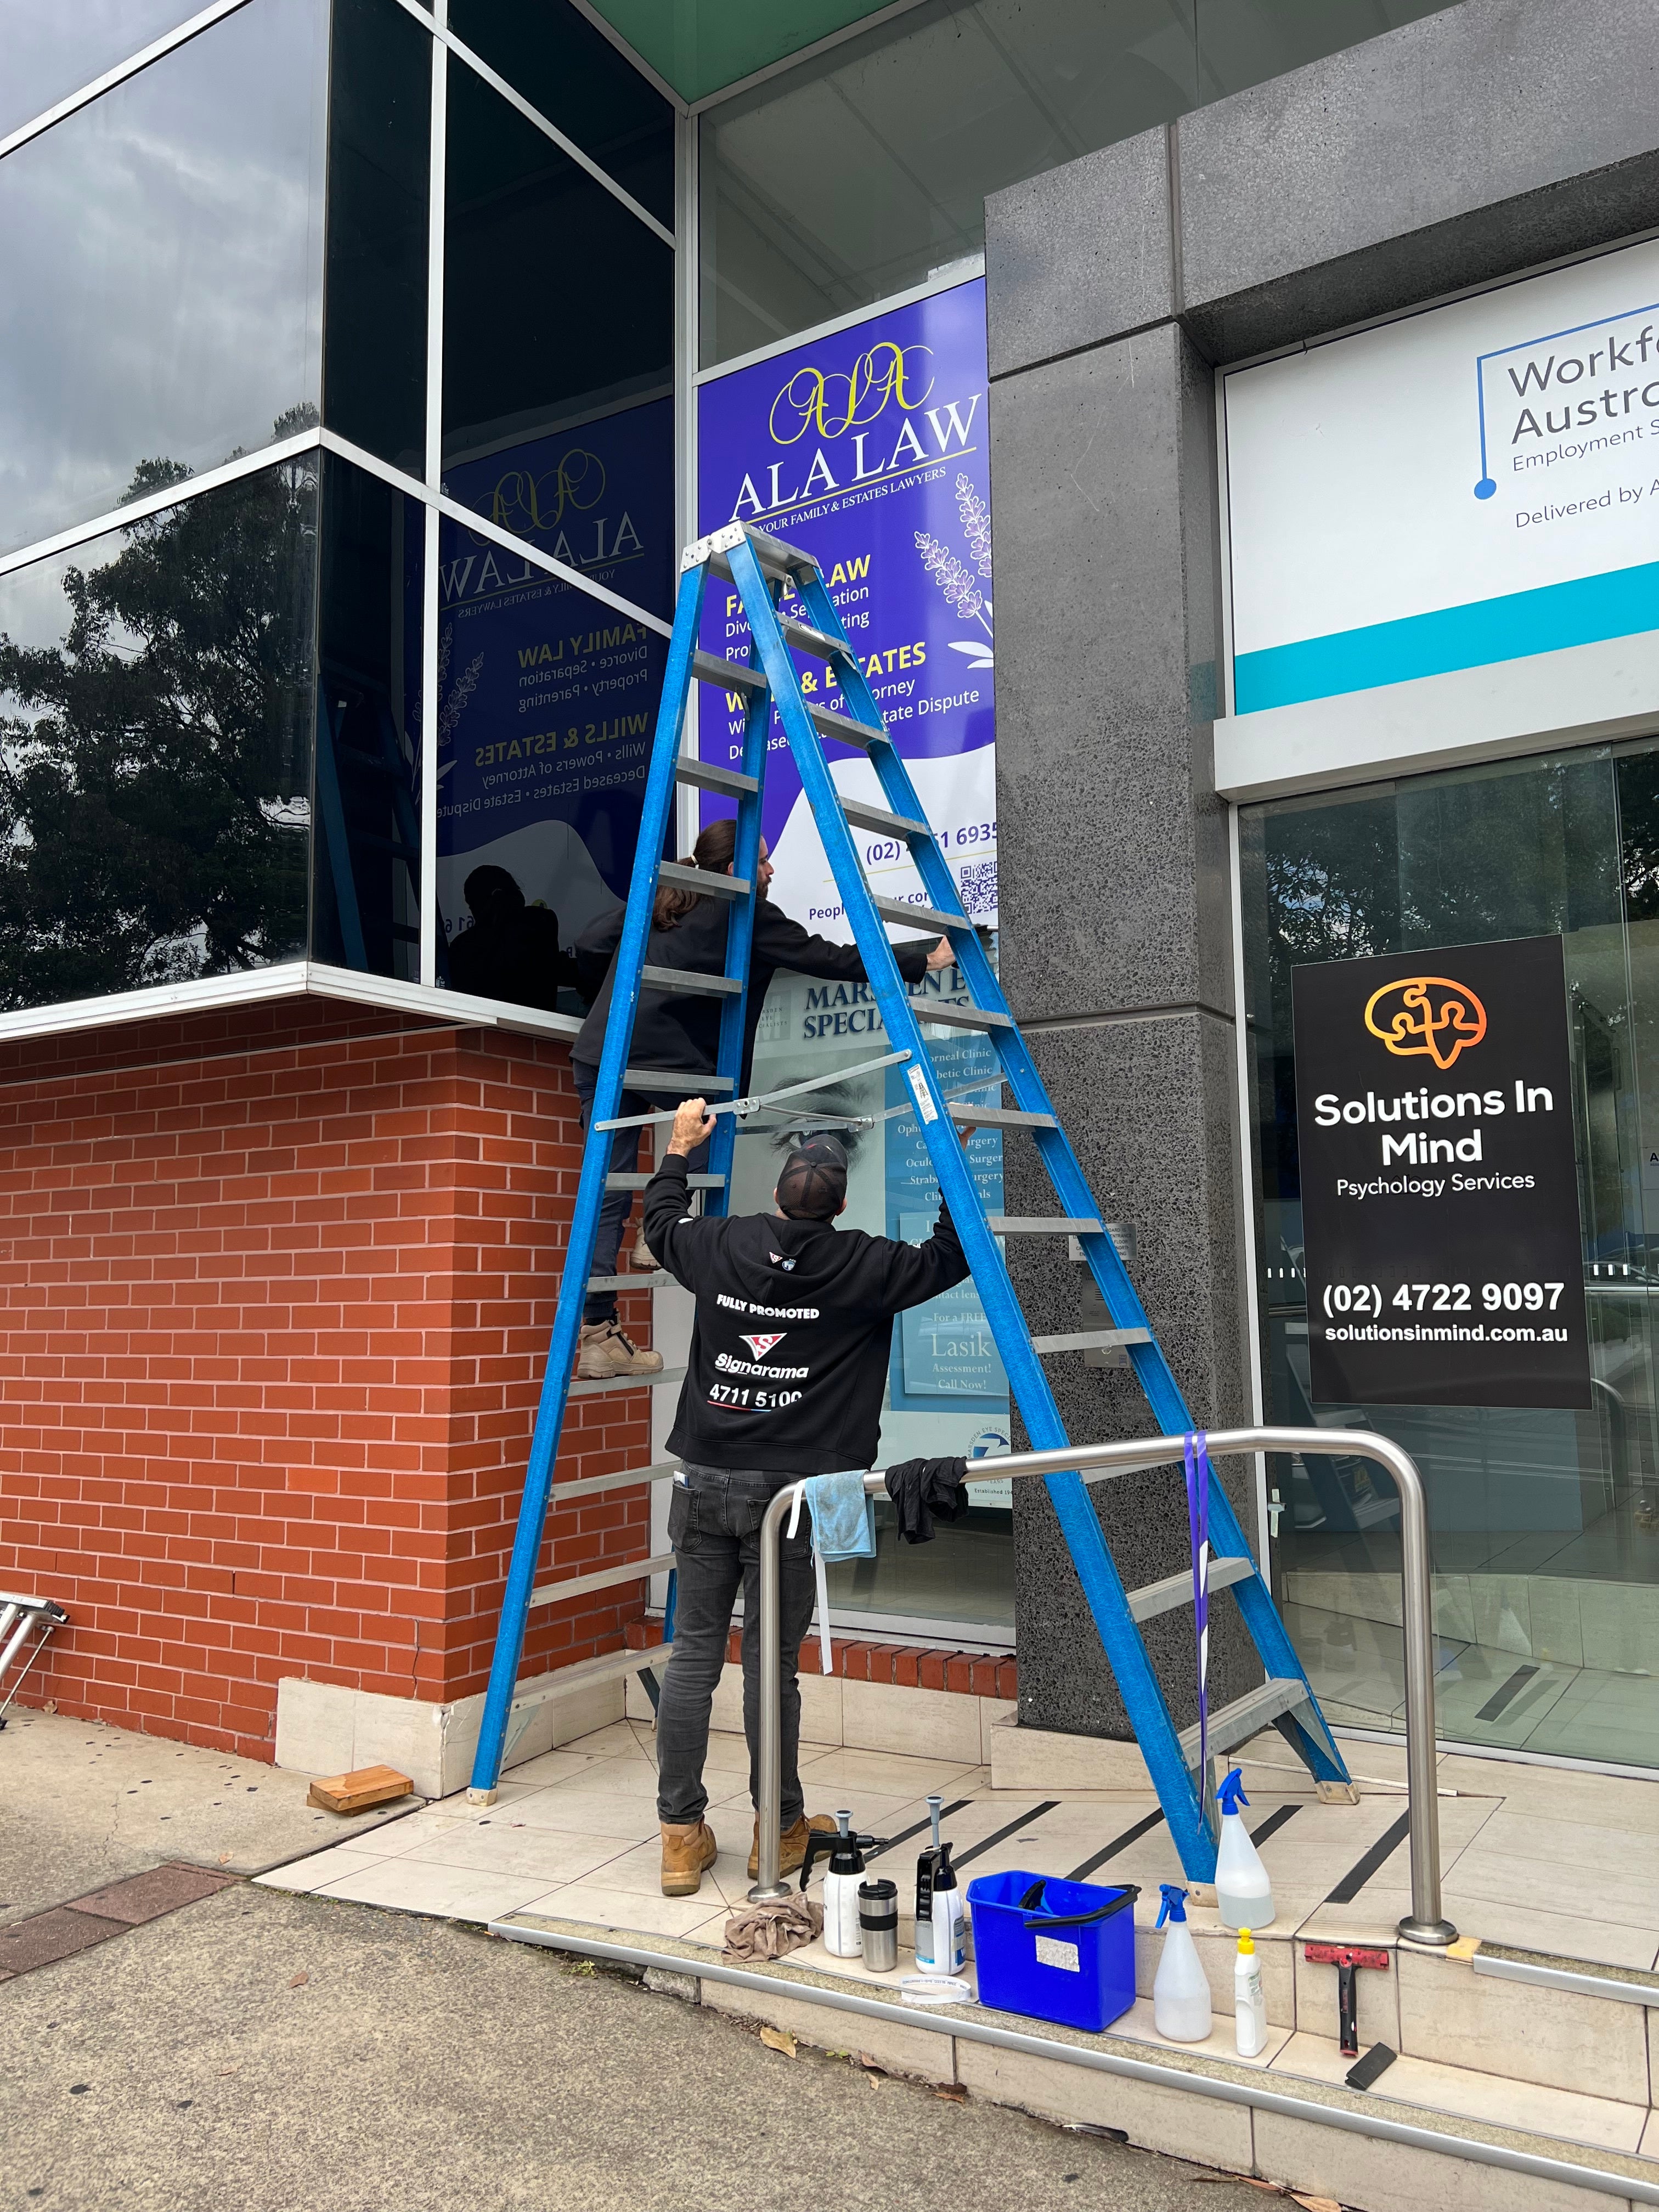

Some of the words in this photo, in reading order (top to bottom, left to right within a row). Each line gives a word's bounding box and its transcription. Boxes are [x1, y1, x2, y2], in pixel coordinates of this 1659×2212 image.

[1508, 325, 1659, 397] Workf
[729, 448, 839, 522] ALA
[851, 394, 981, 483] LAW
[1513, 425, 1644, 471] Employment
[791, 501, 831, 525] FAMILY
[831, 501, 840, 512] &
[842, 484, 888, 508] ESTATES
[890, 466, 946, 493] LAWYERS
[1516, 490, 1611, 528] Delivered
[1620, 486, 1643, 504] by
[825, 554, 871, 588] AW
[918, 690, 979, 715] Dispute
[866, 841, 900, 865] (02)
[930, 1051, 959, 1062] orneal
[962, 1048, 992, 1059] Clinic
[963, 1066, 993, 1076] Clinic
[1314, 1087, 1505, 1126] Solutions
[1515, 1080, 1554, 1113] In
[1382, 1128, 1483, 1166] Mind
[969, 1154, 1003, 1166] Surger
[1337, 1175, 1446, 1200] Psychology
[1452, 1171, 1535, 1192] Services
[716, 1294, 747, 1312] FULLY
[749, 1304, 820, 1319] PROMOTED
[1323, 1284, 1383, 1318] (02)
[1392, 1284, 1472, 1312] 4722
[1482, 1283, 1565, 1311] 9097
[933, 1313, 950, 1322] For
[931, 1332, 992, 1357] Lasik
[1325, 1324, 1568, 1342] solutionsinmind.com.au
[715, 1353, 809, 1379] Signarama
[933, 1363, 991, 1373] Assessment!
[710, 1384, 749, 1406] 4711
[938, 1379, 957, 1389] Call
[960, 1380, 986, 1389] Now!
